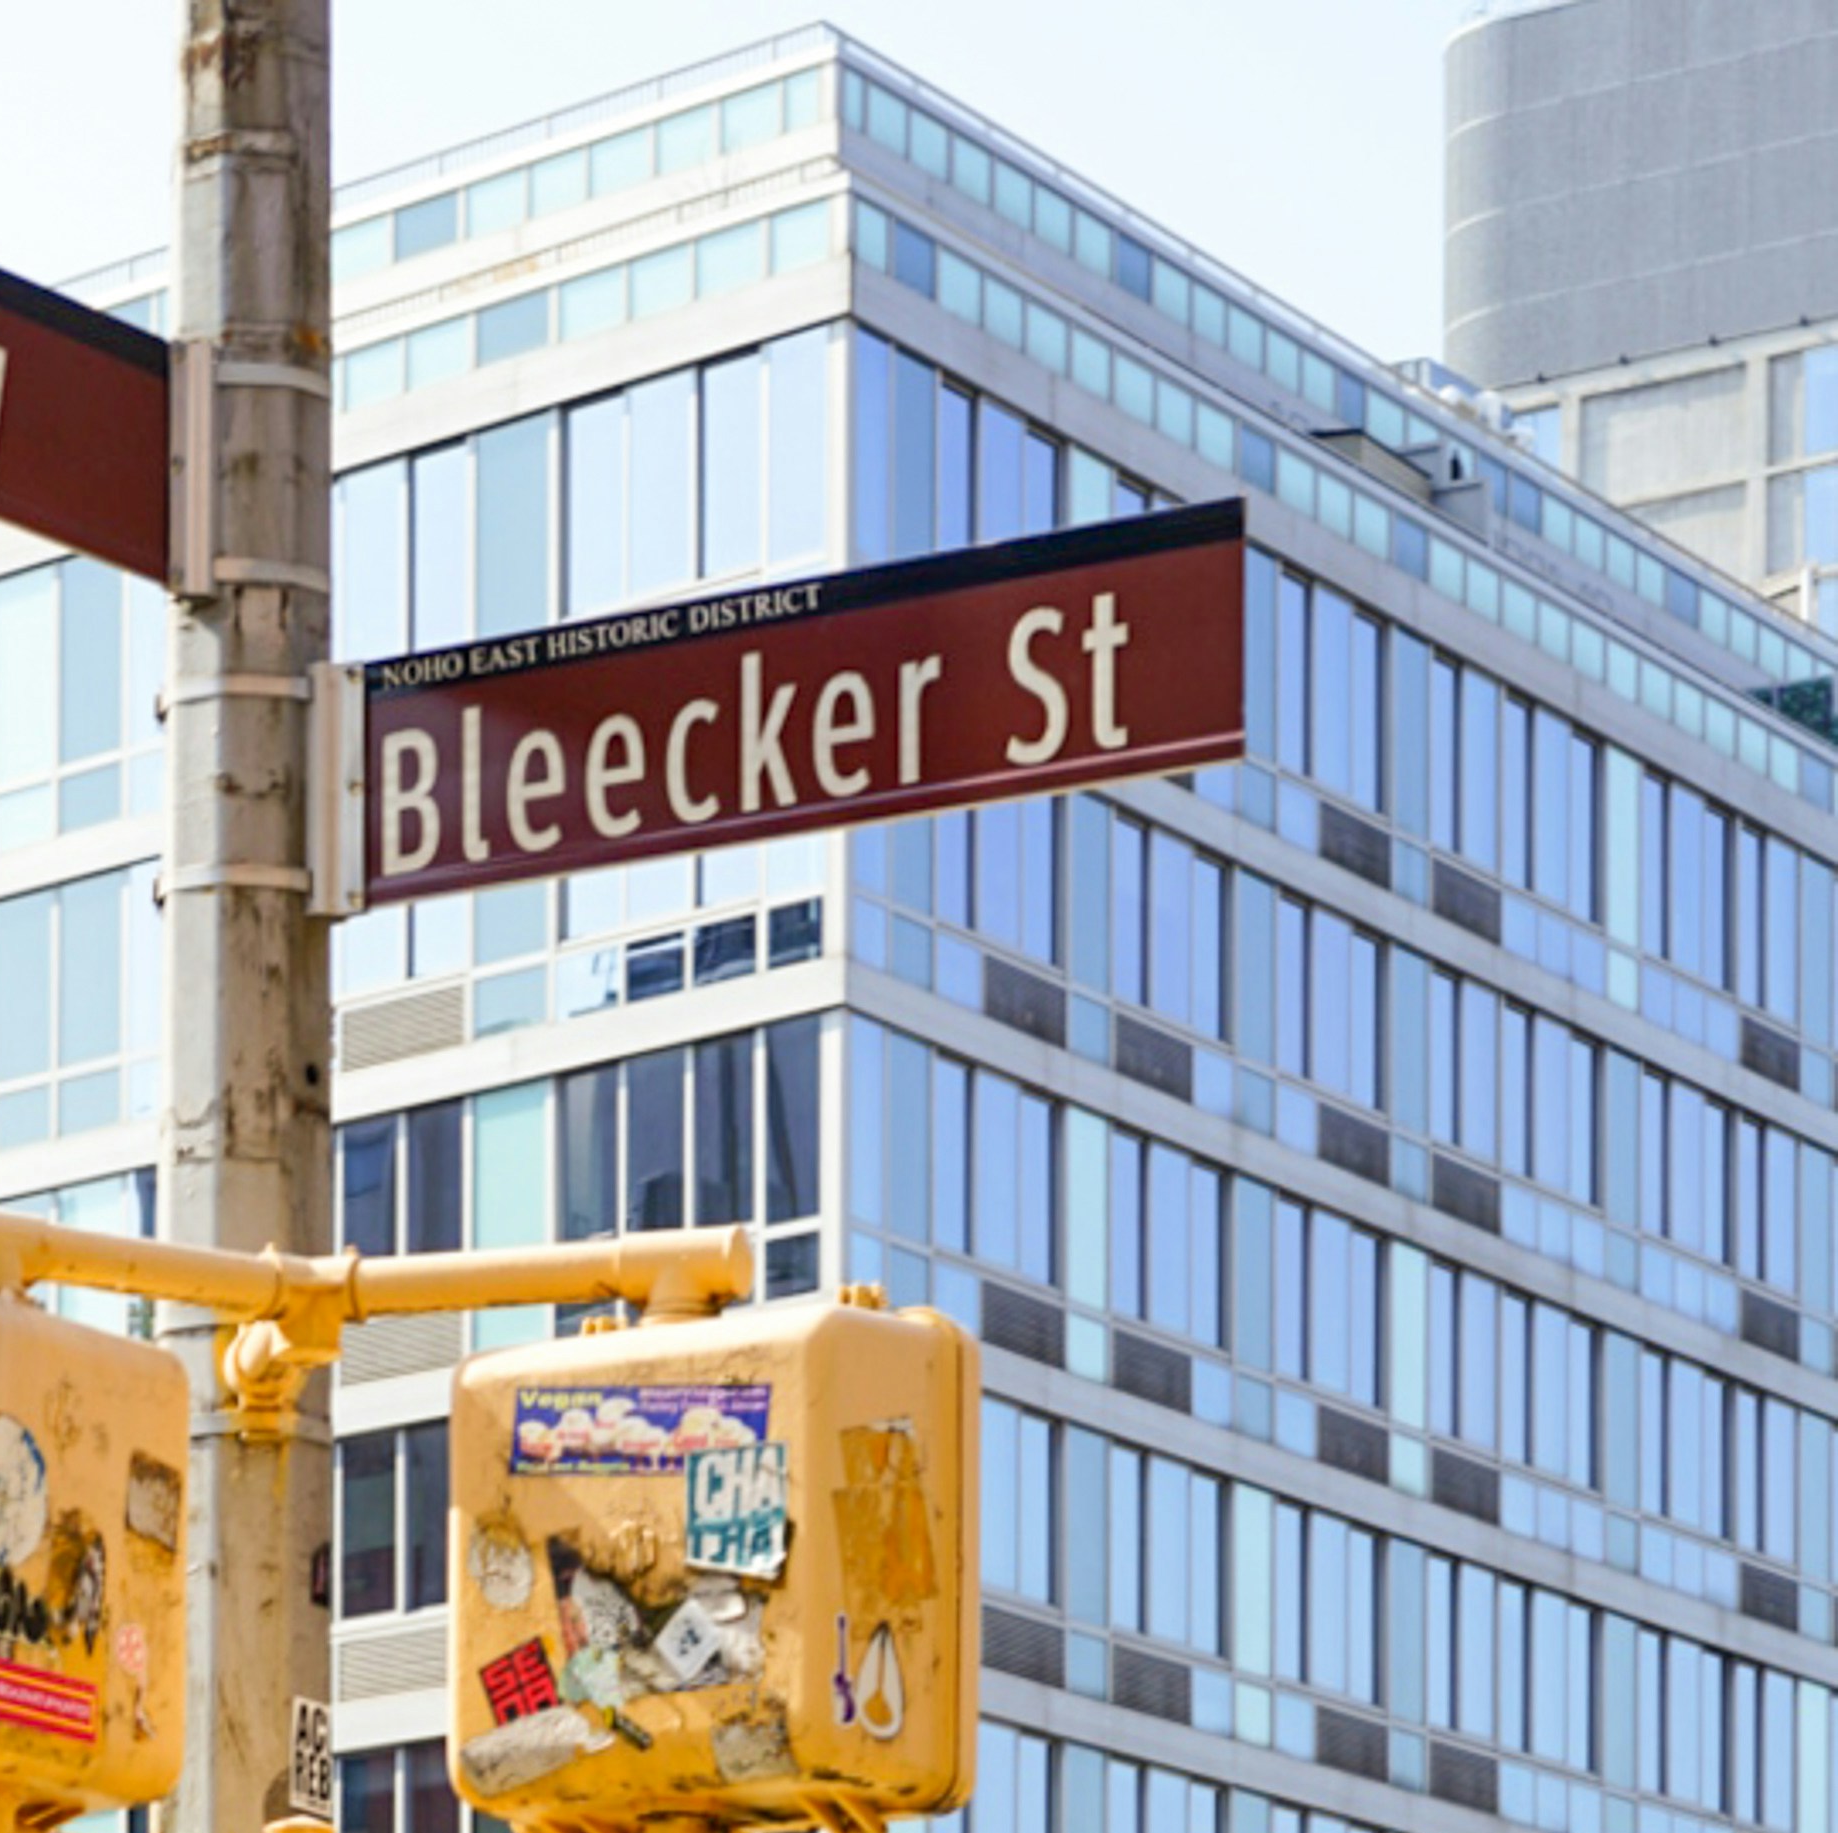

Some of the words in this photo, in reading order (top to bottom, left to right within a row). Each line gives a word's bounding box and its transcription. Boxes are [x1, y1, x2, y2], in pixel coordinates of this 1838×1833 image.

[380, 651, 463, 690] NOHO
[468, 635, 541, 676] EAST
[546, 611, 683, 659] HISTORIC
[688, 582, 823, 634] DISTRICT
[380, 650, 942, 877] Bleecker
[1006, 592, 1130, 768] St
